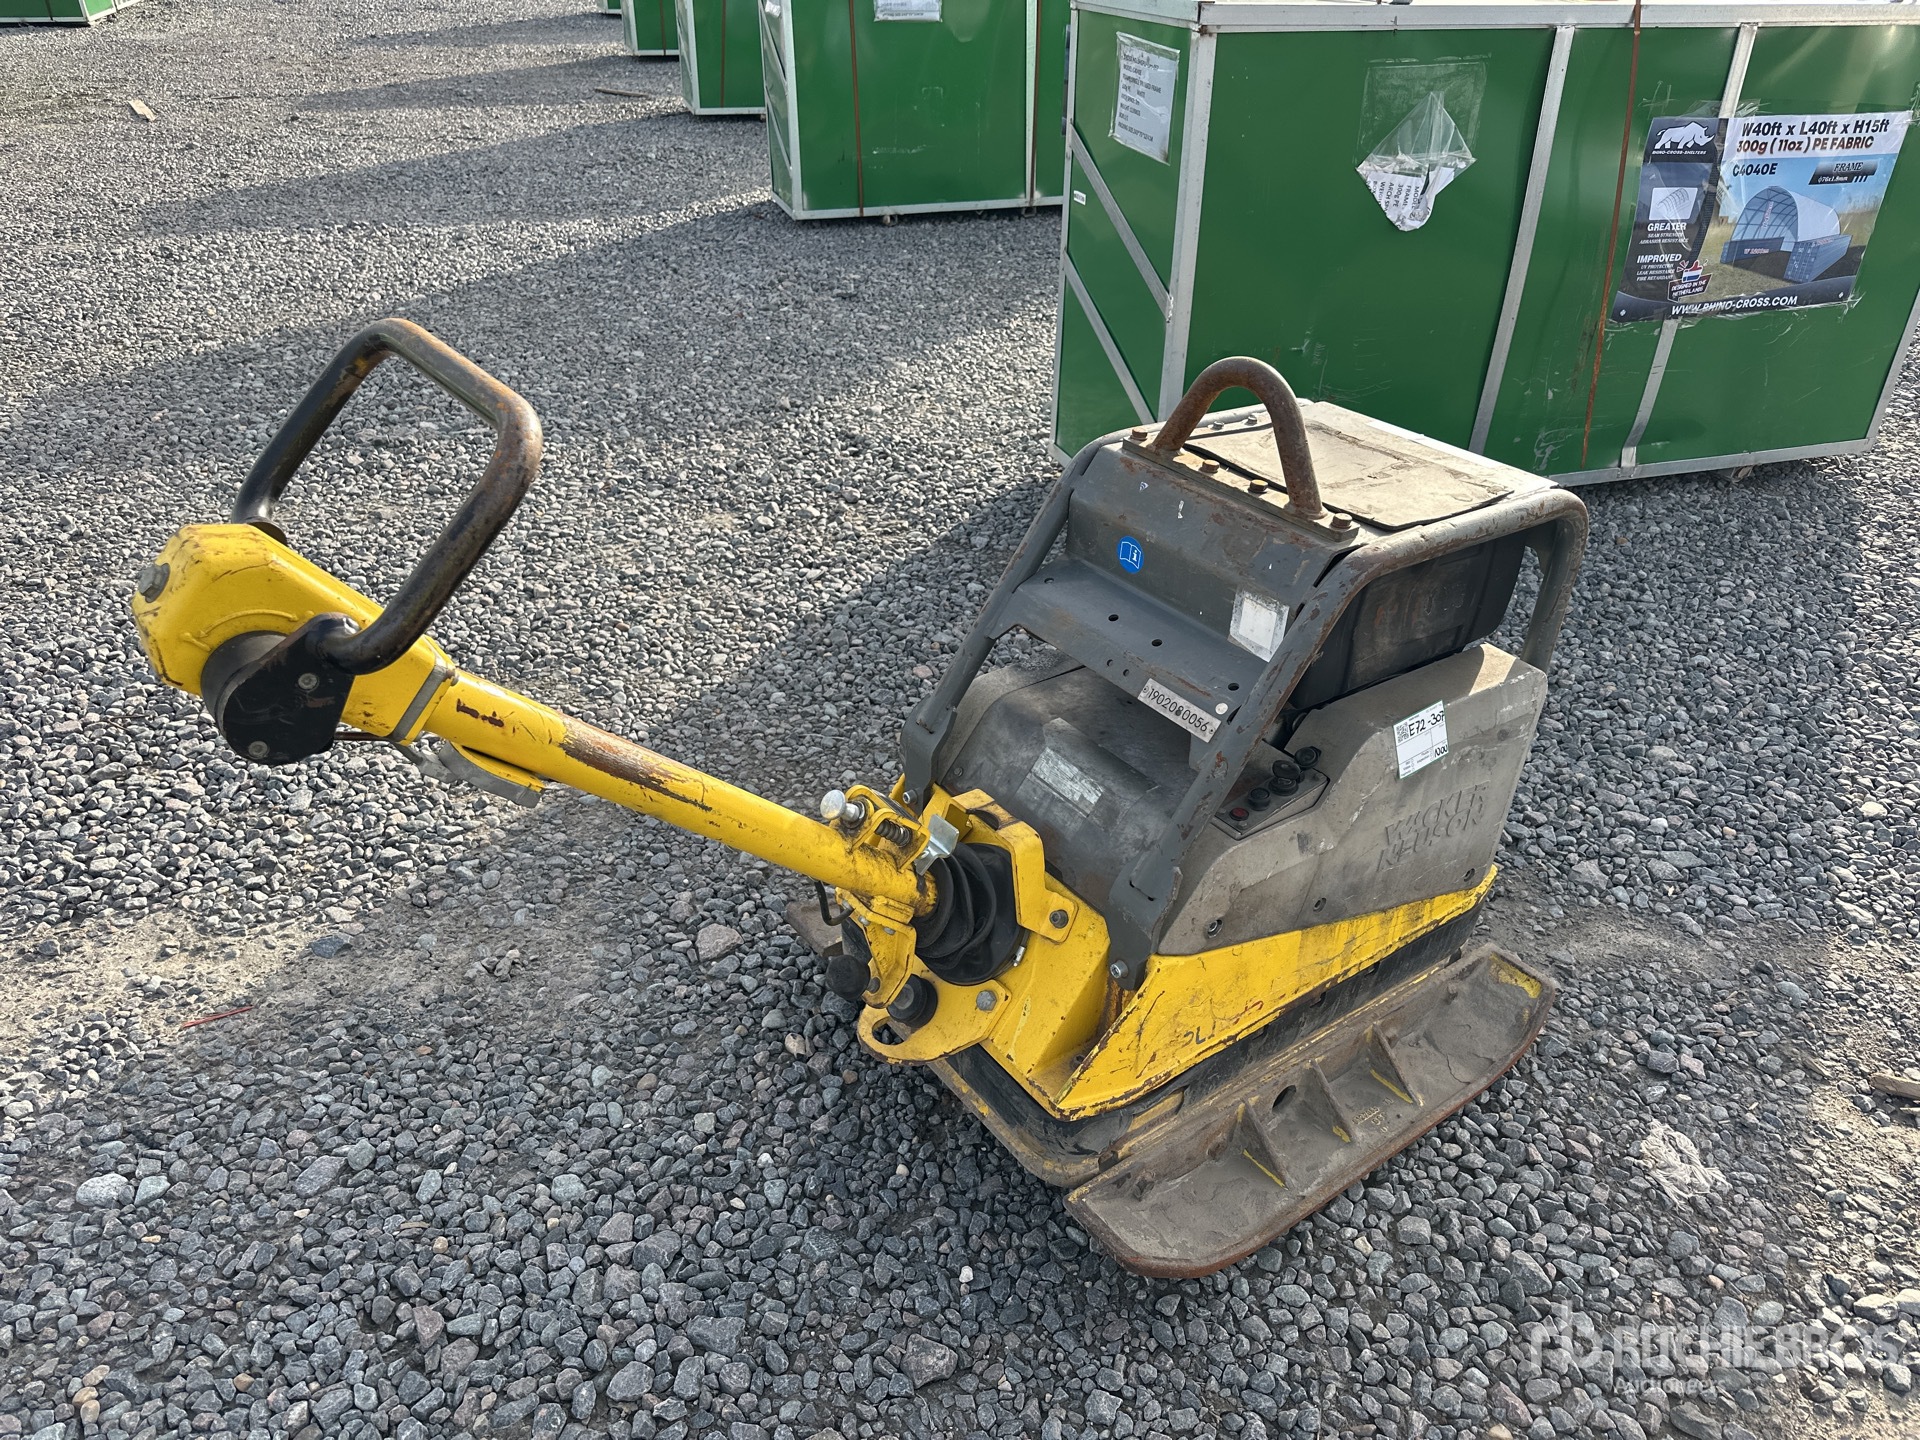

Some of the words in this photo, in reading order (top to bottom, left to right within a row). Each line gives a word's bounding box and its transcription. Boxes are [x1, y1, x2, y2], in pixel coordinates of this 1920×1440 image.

[1742, 122, 1782, 137] W40ft
[1786, 125, 1796, 136] x
[1800, 121, 1837, 135] L40ft
[1840, 123, 1850, 134] x
[1853, 119, 1889, 134] H15ft
[1736, 139, 1767, 156] 300g
[1812, 138, 1827, 151] PE
[1829, 136, 1874, 149] FABRIC
[1732, 162, 1778, 177] C4040E
[1833, 162, 1864, 172] FRAME
[1647, 222, 1687, 231] GREATER
[1636, 253, 1682, 263] IMPROVED
[1147, 688, 1210, 732] 1902080056
